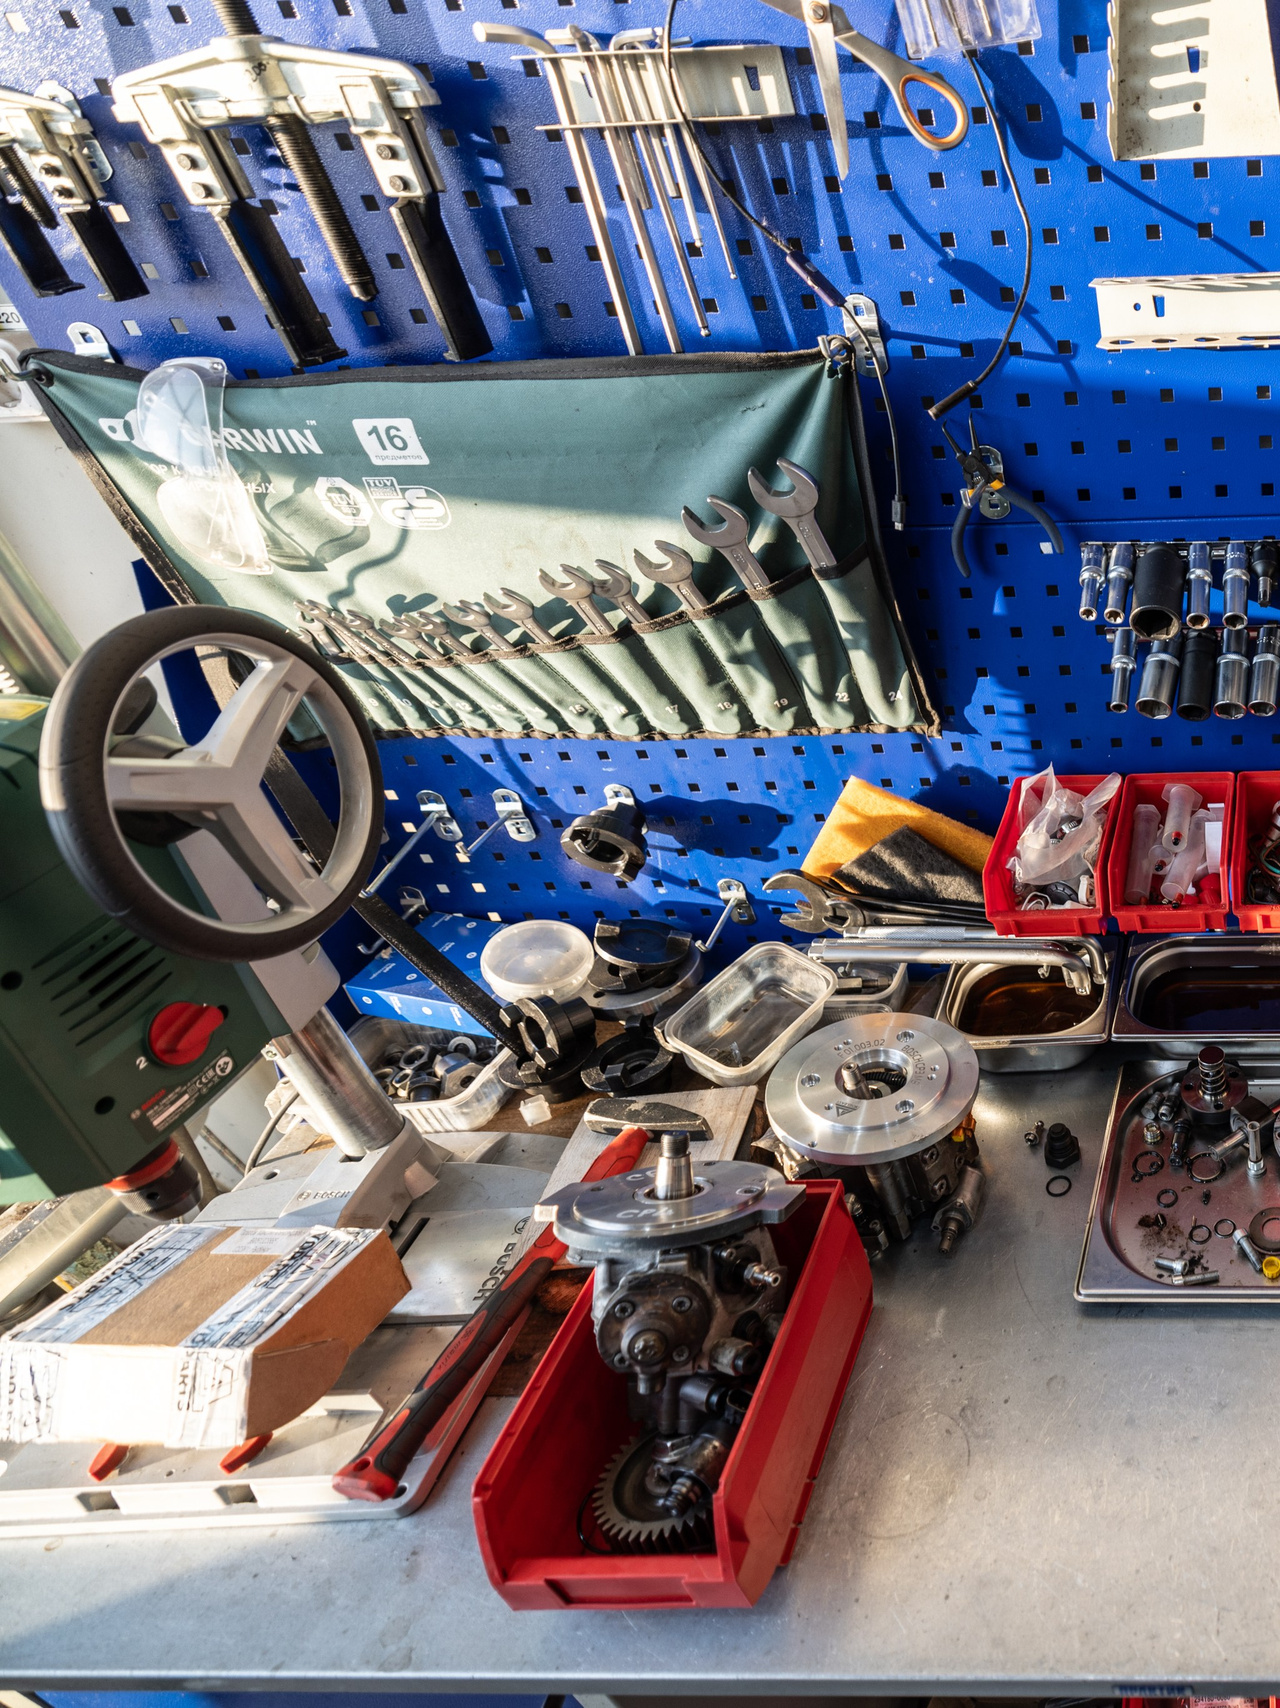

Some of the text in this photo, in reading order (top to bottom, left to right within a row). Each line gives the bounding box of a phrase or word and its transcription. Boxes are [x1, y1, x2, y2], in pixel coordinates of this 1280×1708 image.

[367, 425, 410, 452] 16
[374, 453, 424, 463] предметов
[835, 691, 850, 703] 22
[888, 689, 903, 702] 24
[717, 701, 733, 712] 18
[773, 697, 789, 709] 19
[135, 1056, 148, 1070] 2
[141, 1088, 166, 1111] BOSCH
[313, 1190, 351, 1200] BOSCH
[615, 1206, 674, 1219] CP4
